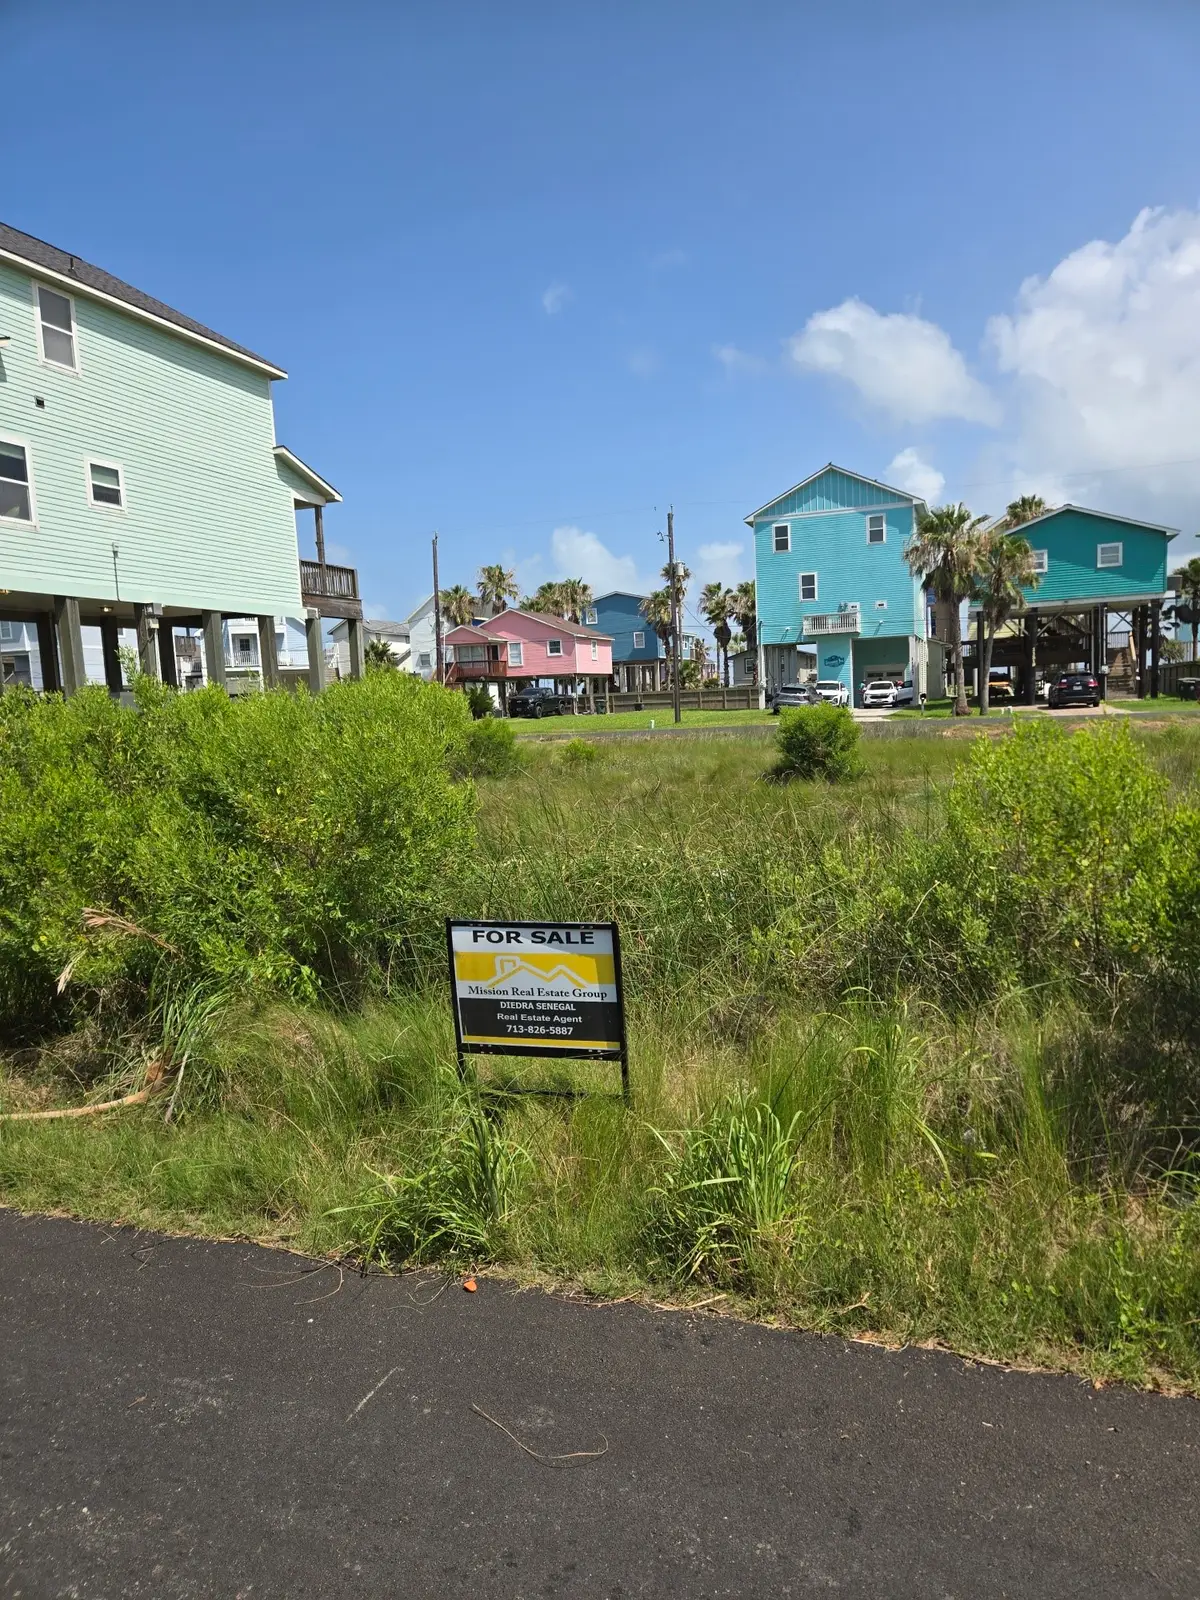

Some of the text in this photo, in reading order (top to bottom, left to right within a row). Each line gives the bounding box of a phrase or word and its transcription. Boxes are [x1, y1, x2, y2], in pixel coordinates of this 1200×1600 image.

[472, 930, 595, 945] FOR SALE
[468, 985, 608, 1001] Mission Real Estate Group
[500, 1001, 576, 1011] DIEDRA SENEGAL
[497, 1013, 583, 1024] Real Estate Agent
[506, 1025, 573, 1035] 713-826-5887
